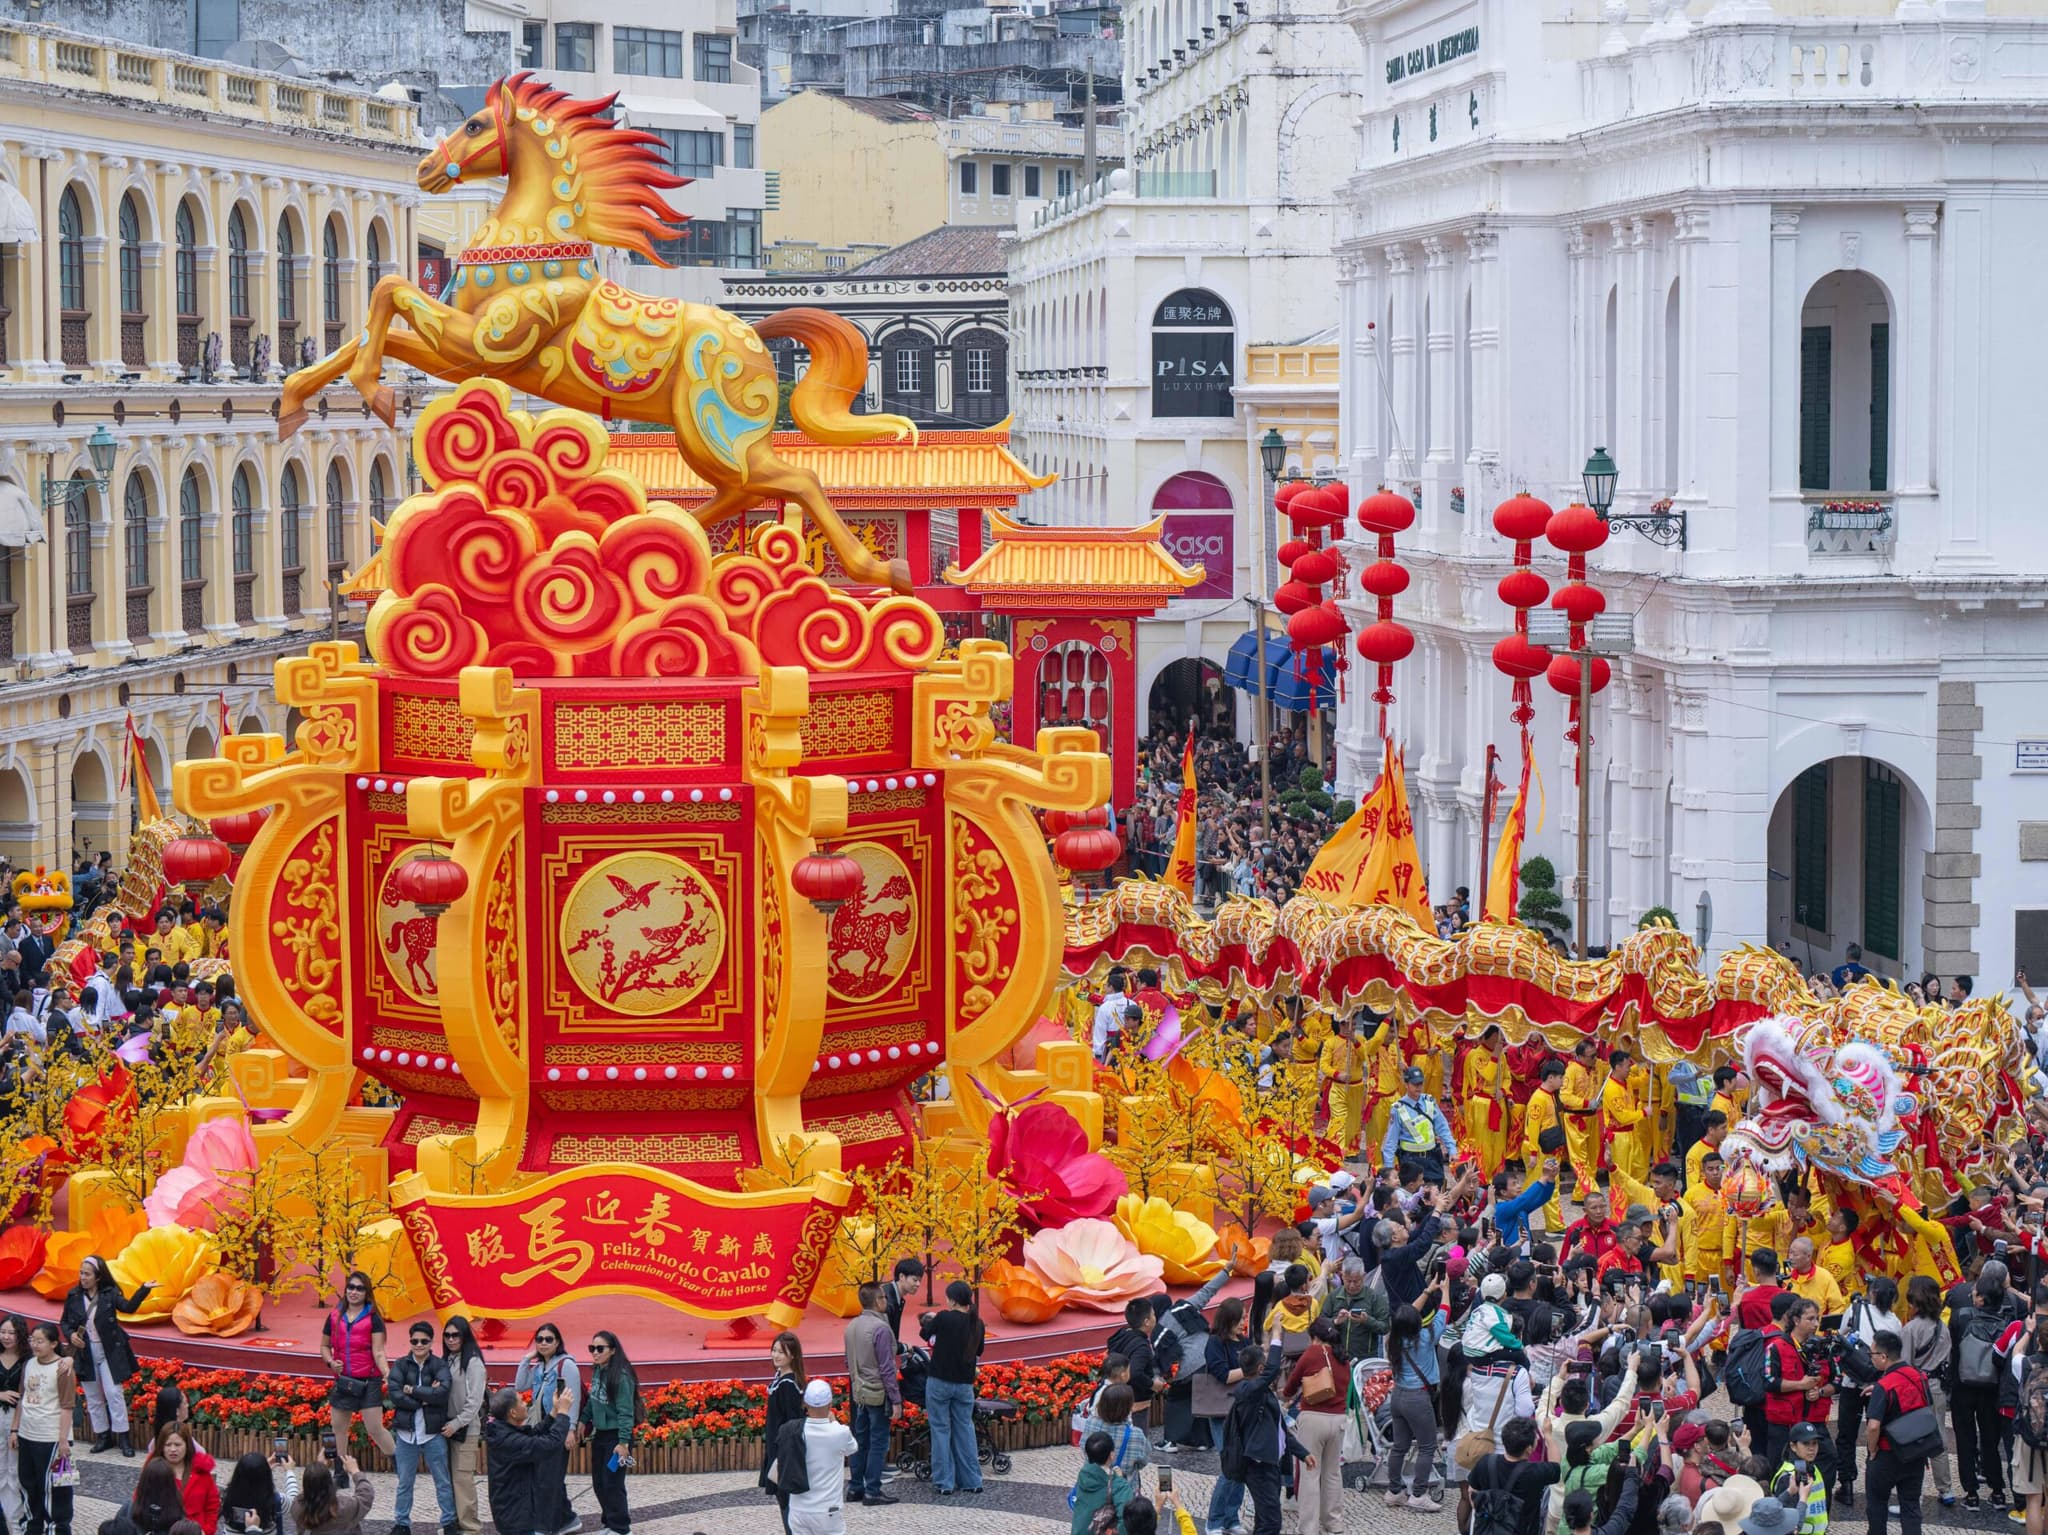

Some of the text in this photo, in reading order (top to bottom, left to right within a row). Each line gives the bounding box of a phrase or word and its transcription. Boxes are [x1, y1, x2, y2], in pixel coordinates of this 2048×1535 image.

[1386, 56, 1405, 84] SANTA
[1407, 47, 1425, 76] CASA
[1426, 43, 1436, 69] DA
[1163, 306, 1222, 321] 匯聚名牌
[1156, 357, 1231, 377] PISA
[1163, 382, 1225, 392] LUXURY
[602, 1241, 771, 1284] Feliz Ano do Cavalo
[600, 1259, 768, 1298] Celebration of Year of the Horse
